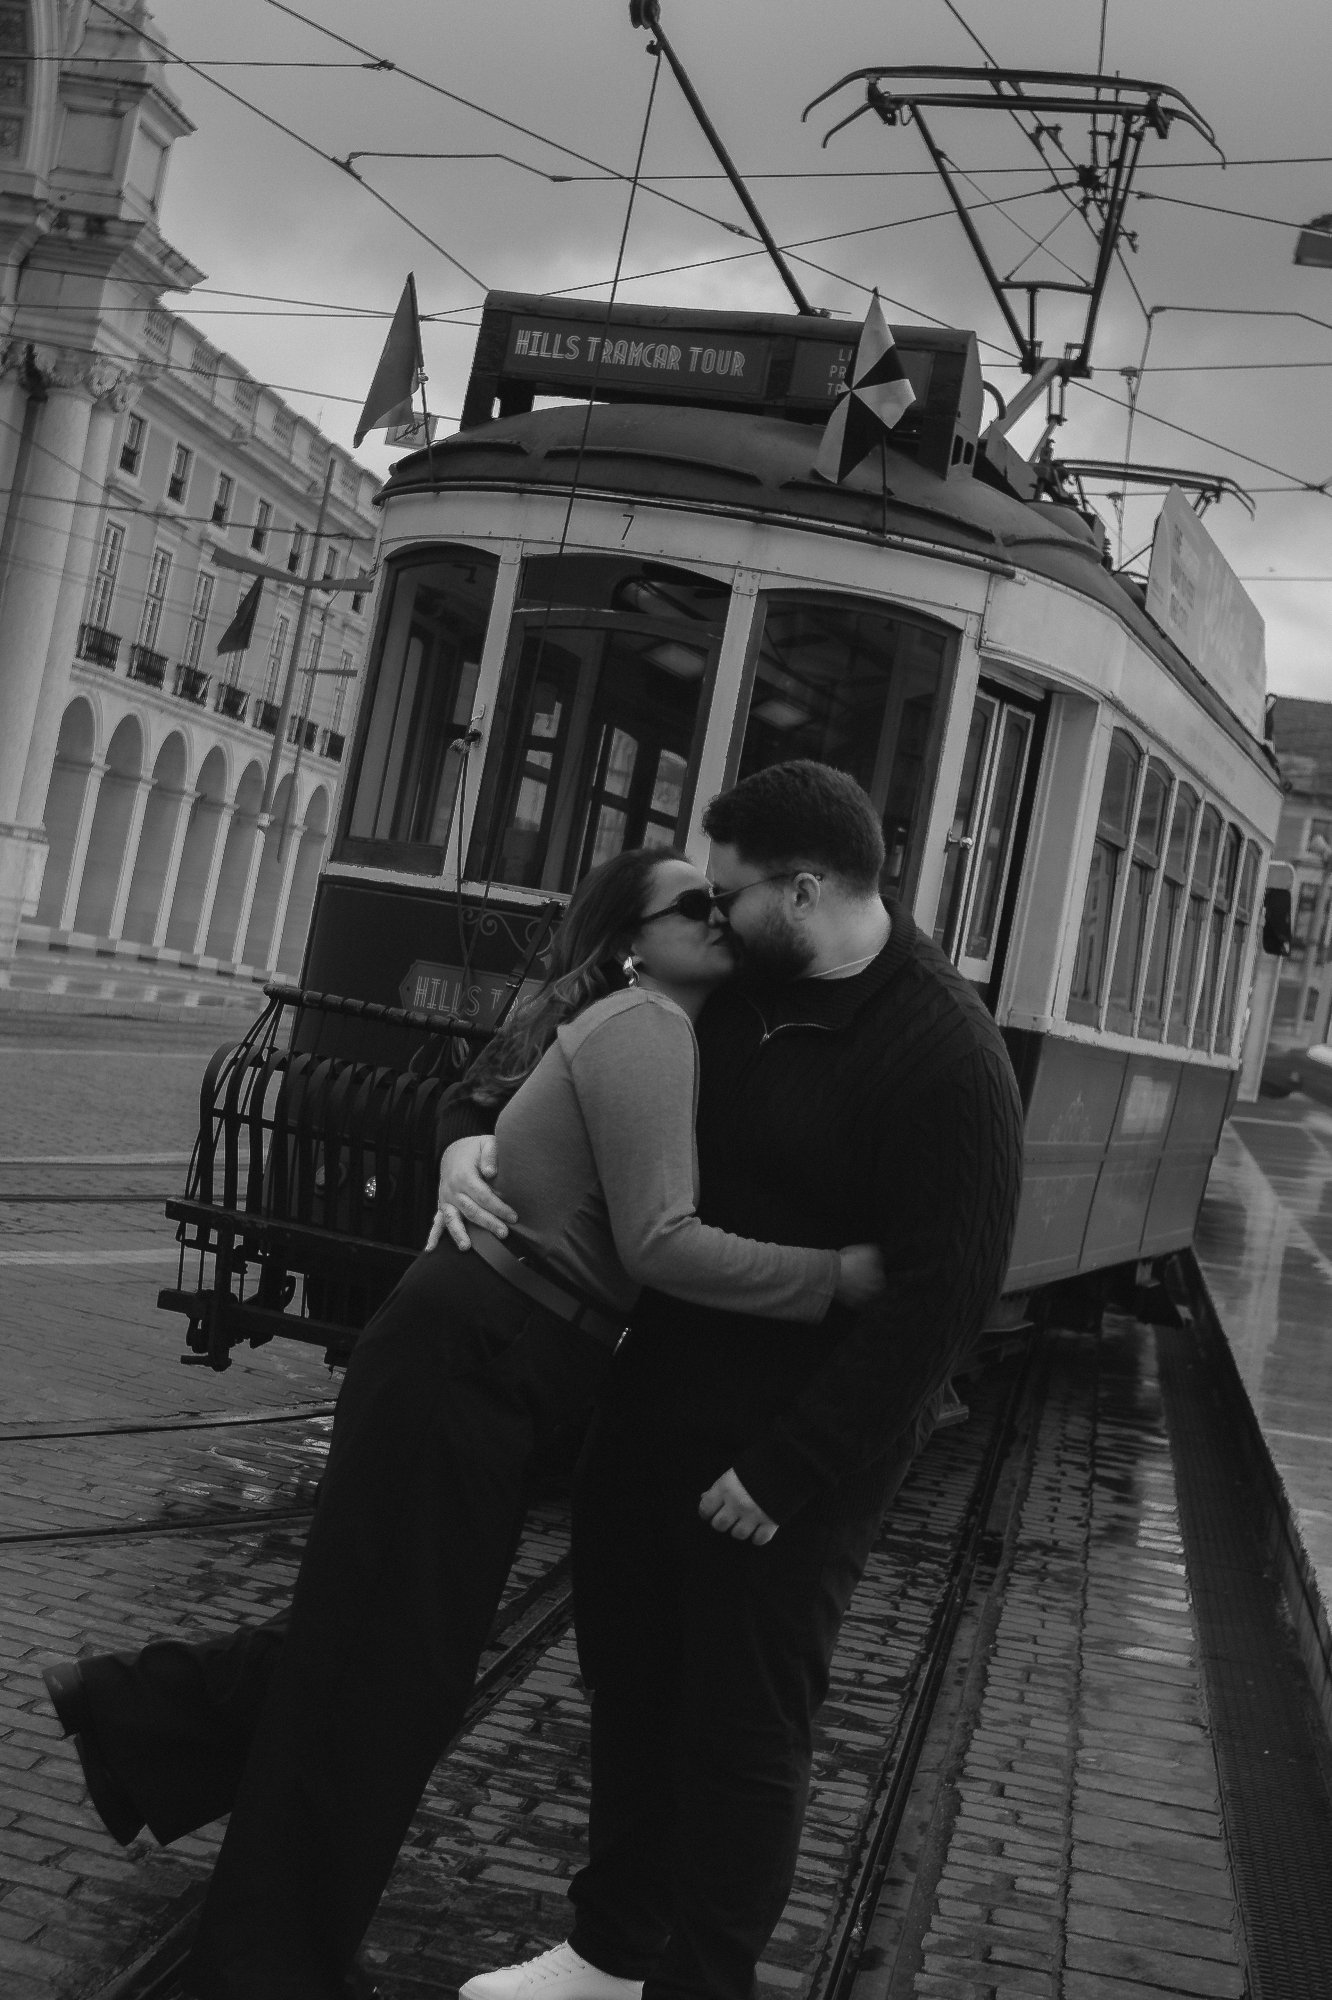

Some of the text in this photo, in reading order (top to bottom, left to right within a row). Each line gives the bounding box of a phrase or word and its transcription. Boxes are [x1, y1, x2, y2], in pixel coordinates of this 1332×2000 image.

[514, 329, 746, 377] HILLS TRAMCAR TOUR
[622, 513, 634, 540] 7
[414, 975, 481, 1017] HILLS
